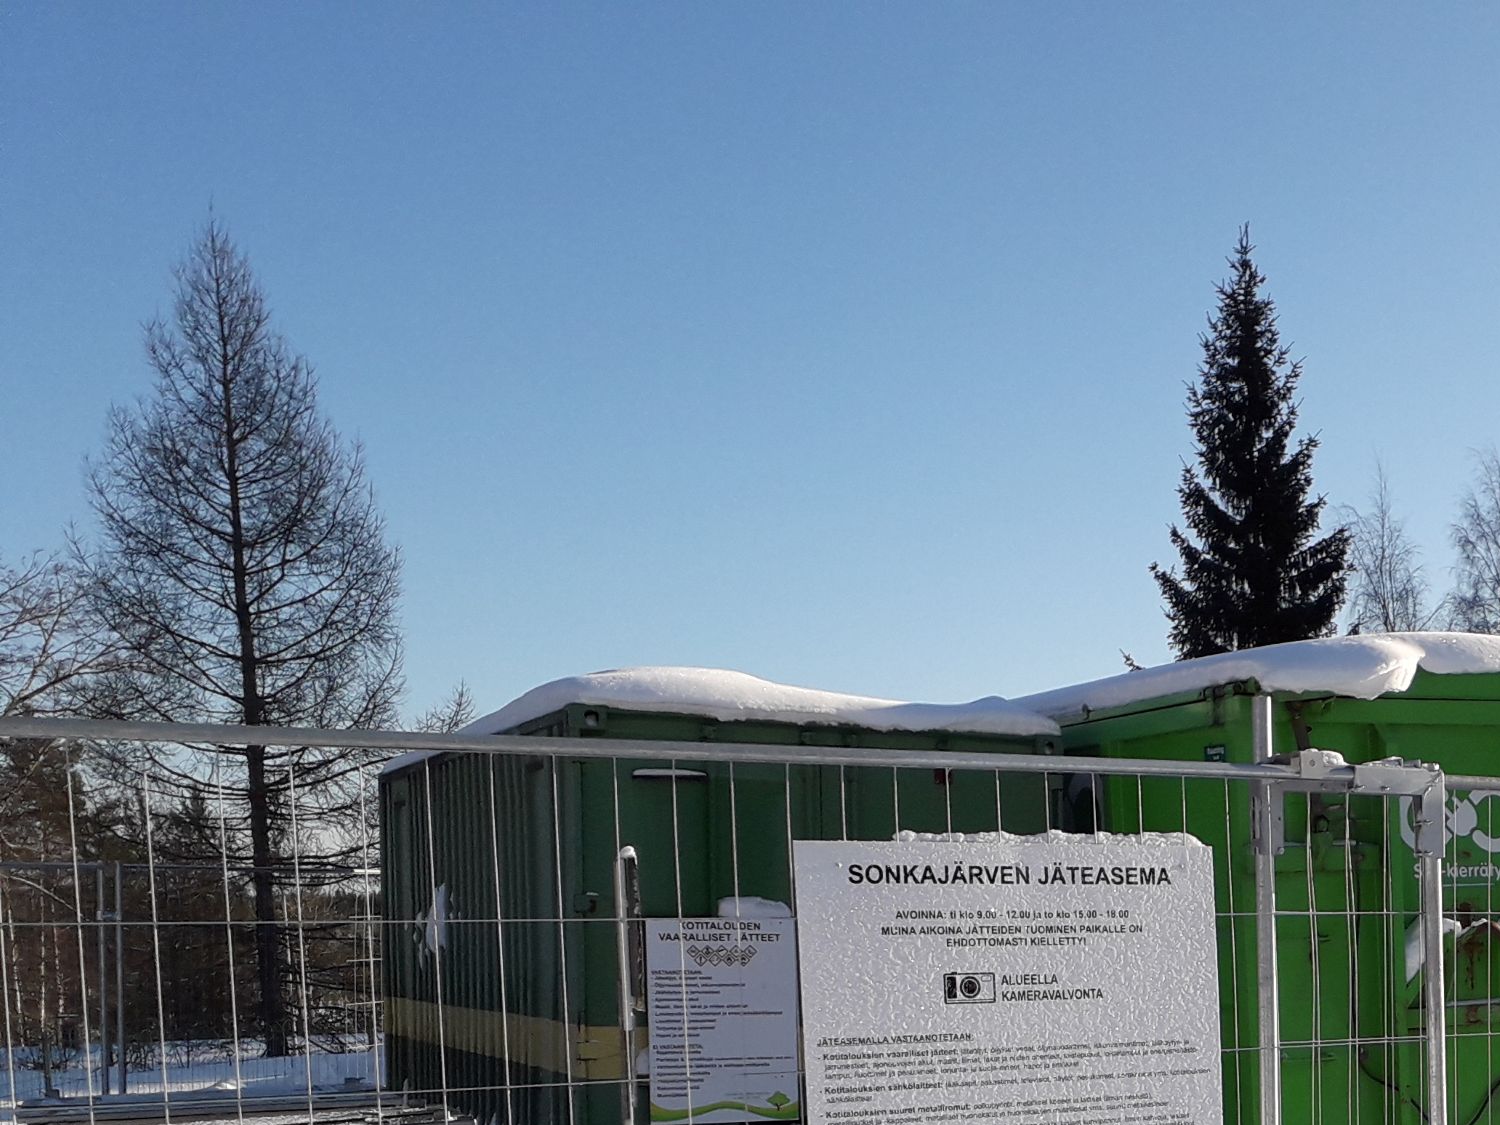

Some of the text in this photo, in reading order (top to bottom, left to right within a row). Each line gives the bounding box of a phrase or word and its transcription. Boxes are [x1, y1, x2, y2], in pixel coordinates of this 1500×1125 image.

[848, 861, 1172, 885] SONKAJÄRVEN JÄTEASEMA
[895, 910, 946, 919] AVOINNA:
[959, 910, 974, 919] klo
[976, 910, 997, 918] 9.00
[1006, 910, 1031, 918] 12.00
[1033, 910, 1041, 920] ja
[1043, 910, 1054, 918] to
[1056, 909, 1070, 918] klo
[1073, 909, 1097, 918] 15.00
[1106, 909, 1129, 918] 18.00
[918, 925, 963, 935] AIKOINA
[1025, 924, 1076, 934] TUOMINEN
[1079, 924, 1126, 933] PAIKALLE
[1128, 924, 1142, 932] ON
[734, 931, 780, 941] ÄTTEET
[946, 937, 1027, 947] EHDOTTOMASTI
[1001, 974, 1058, 986] ALUEELLA
[1001, 988, 1104, 1001] KAMERAVALVONTA
[816, 1032, 974, 1047] JÄTEASEMALLA VASTAANOTETAAN:
[822, 1051, 884, 1060] Kotitalouksien
[886, 1049, 928, 1058] vaaralliset
[824, 1084, 885, 1094] Kotitalouksien
[825, 1108, 887, 1118] Kotitalouksien
[888, 1106, 915, 1115] suuret
